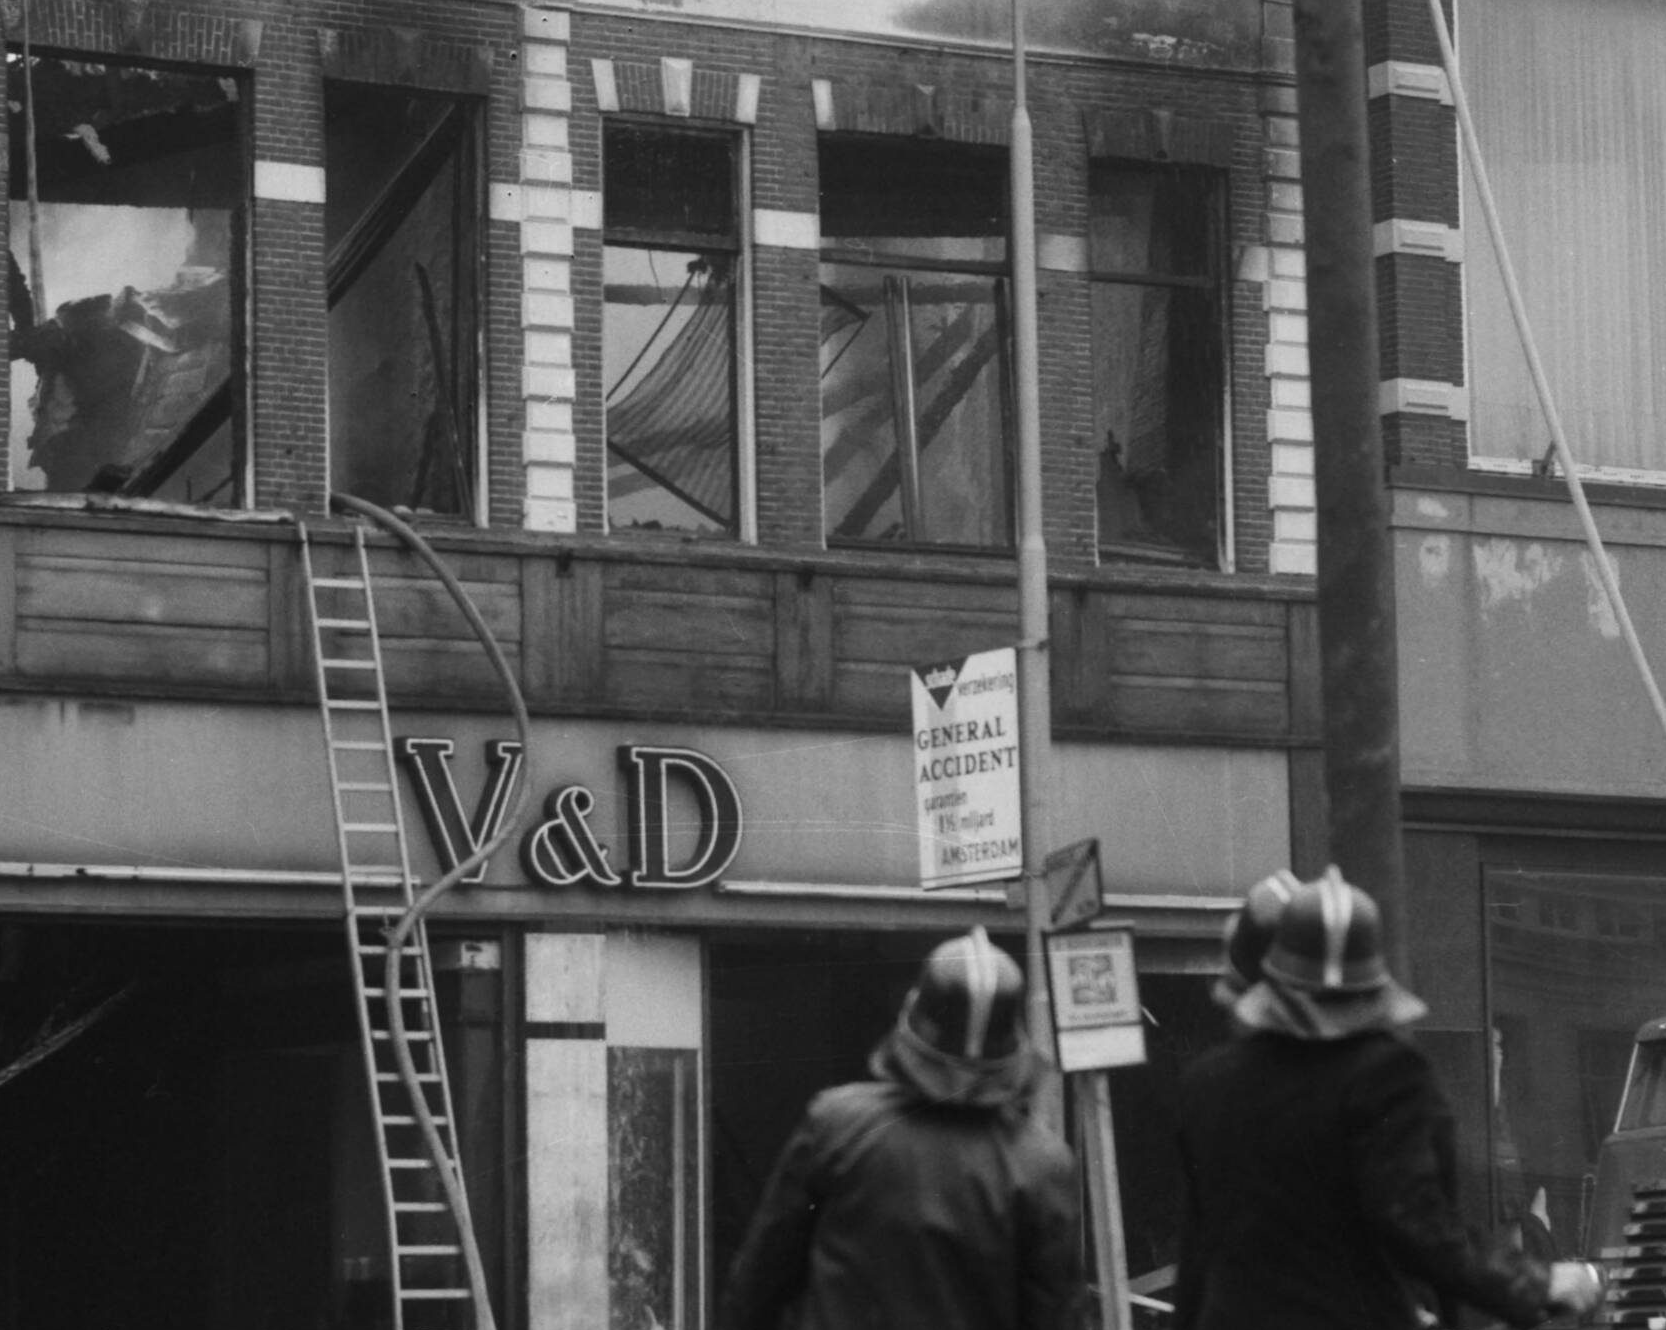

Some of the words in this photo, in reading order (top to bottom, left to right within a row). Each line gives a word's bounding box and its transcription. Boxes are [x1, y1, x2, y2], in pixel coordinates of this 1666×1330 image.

[916, 716, 1006, 751] GENERAL
[919, 746, 1018, 783] ACCIDENT
[393, 736, 743, 887] V&D
[941, 837, 1019, 866] AMSTERDAM
